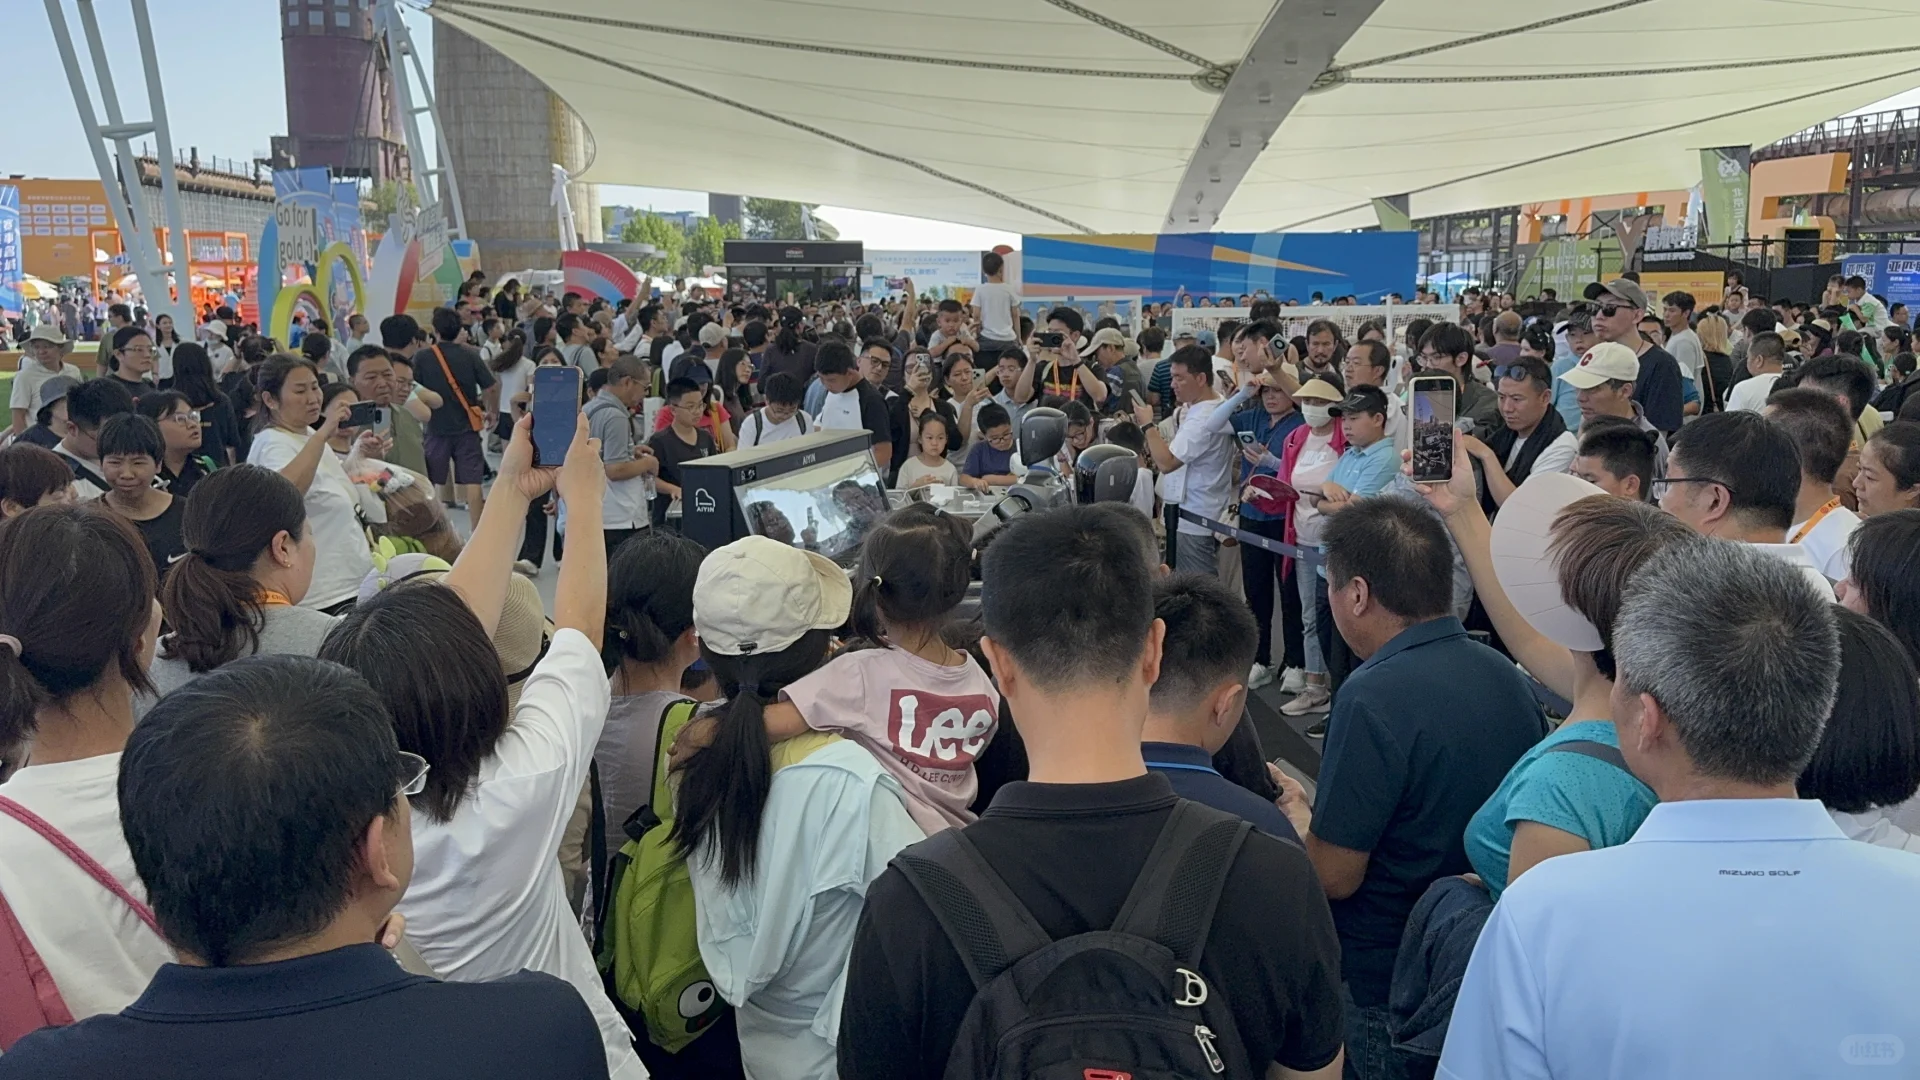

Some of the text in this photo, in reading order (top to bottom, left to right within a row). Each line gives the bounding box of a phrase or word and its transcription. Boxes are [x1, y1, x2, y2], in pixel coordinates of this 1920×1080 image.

[276, 201, 308, 228] Go for
[279, 235, 303, 270] gold
[1580, 352, 1593, 367] C
[802, 453, 816, 466] AIYIN
[899, 695, 993, 761] Lee
[1719, 869, 1764, 877] MIZUNO
